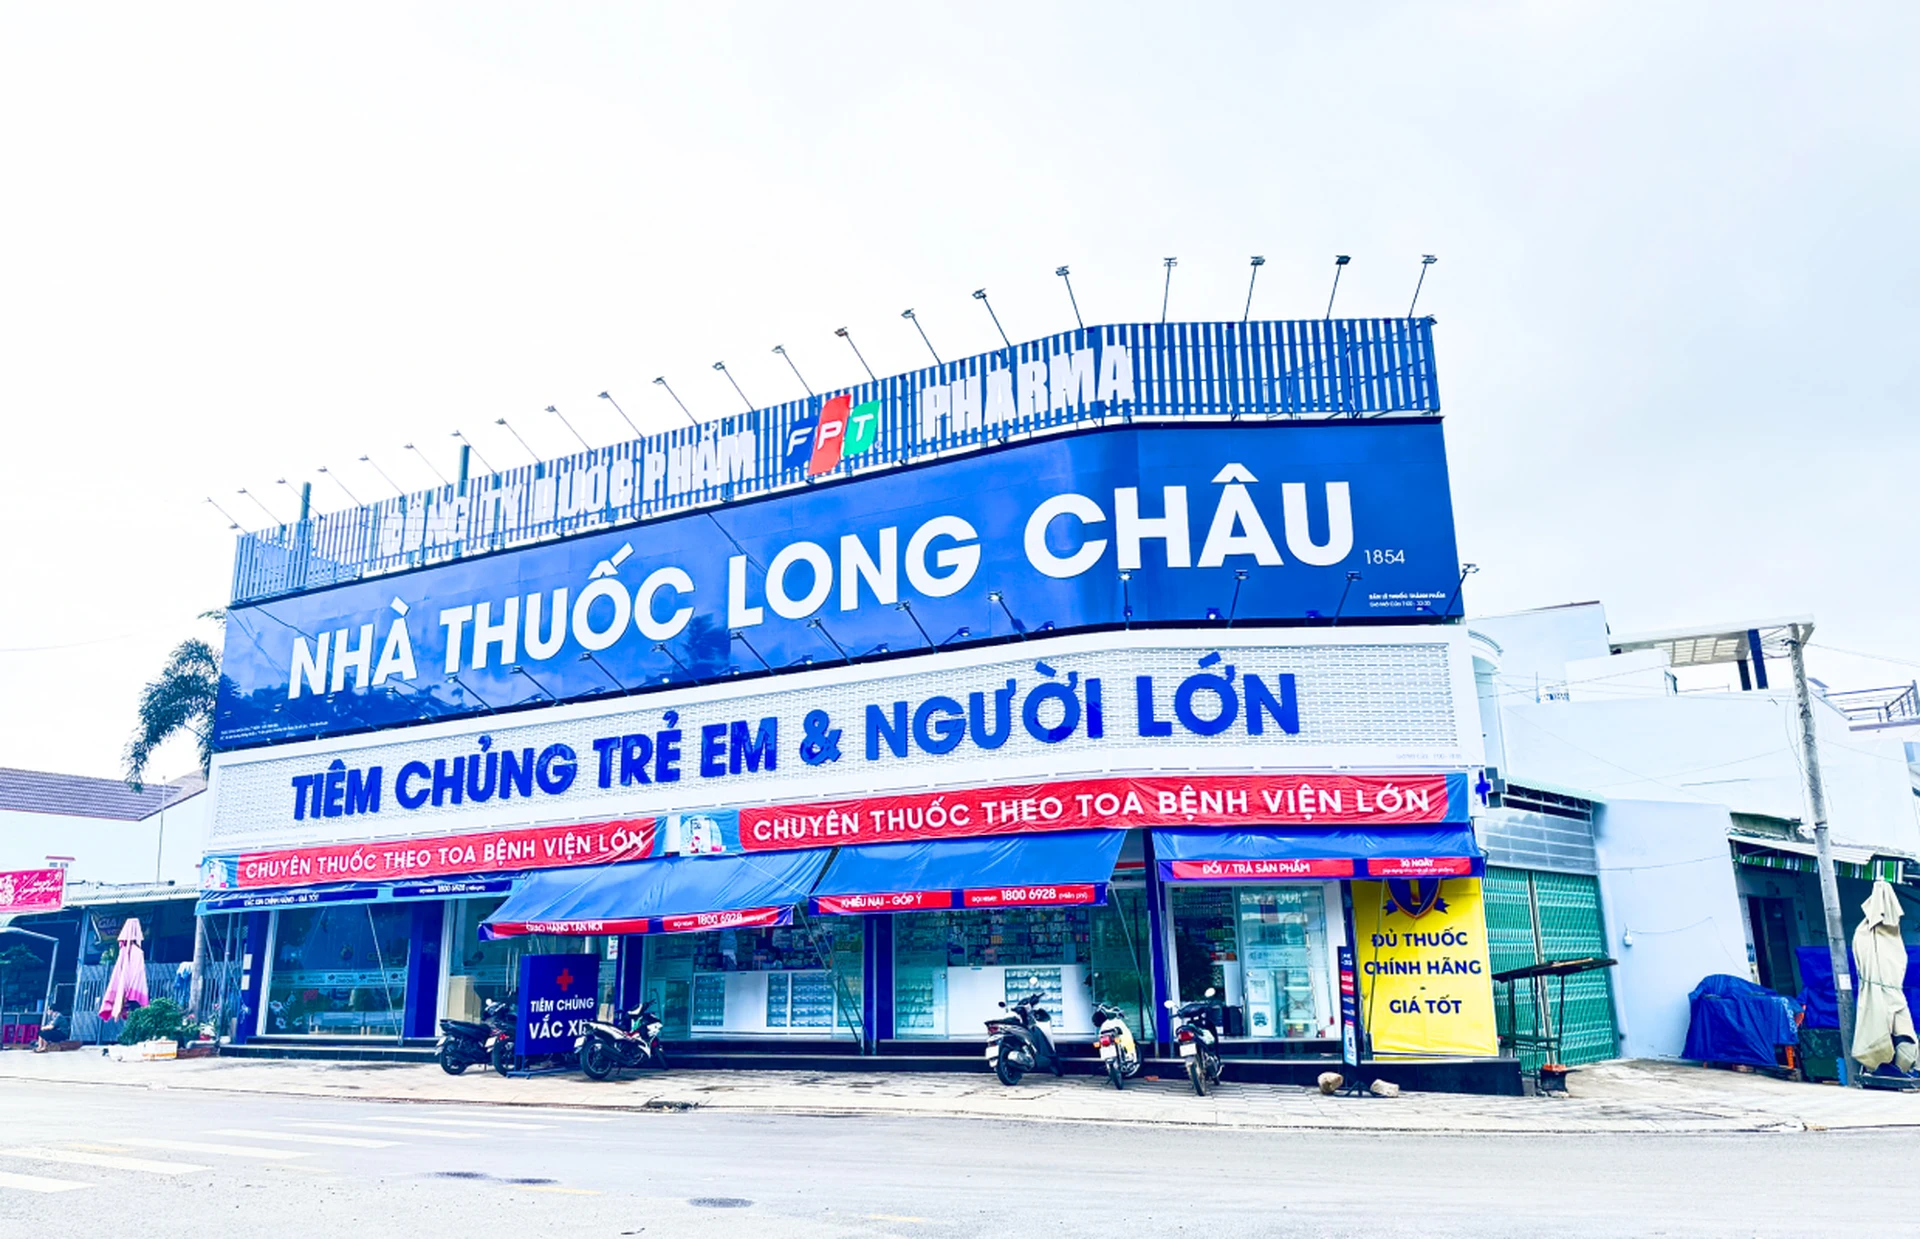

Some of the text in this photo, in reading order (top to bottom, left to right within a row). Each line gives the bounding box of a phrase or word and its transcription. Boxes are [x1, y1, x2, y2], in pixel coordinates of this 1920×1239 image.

[921, 343, 1136, 441] PHARMA
[786, 413, 875, 456] FPT
[1364, 549, 1405, 565] 1854
[288, 462, 1354, 700] NHÀ THUỐC LONG CHÂU
[292, 651, 1300, 820] TIÊM CHỦNG TRẺ EM & NGƯỜI LỚN
[752, 782, 1430, 842] CHUYÊN THUỐC THEO TOA BỆNH VIỆN LỚN
[245, 826, 644, 879] CHUYÊN THUỐC THEO TOA BỆNH VIỆN LỚN
[892, 893, 914, 905] GÓP
[915, 892, 922, 904] Ý
[1001, 889, 1027, 901] 1800
[1029, 888, 1056, 901] 6928
[697, 914, 718, 926] 1800
[720, 911, 743, 924] 6928
[1371, 926, 1468, 947] ĐỦ THUỐC
[1364, 957, 1421, 975] CHÍNH
[1427, 956, 1482, 975] HÃNG
[530, 994, 595, 1012] TIÊM CHỦNG
[1389, 994, 1462, 1014] GIÁ TỐT
[529, 1013, 563, 1040] VẮC
